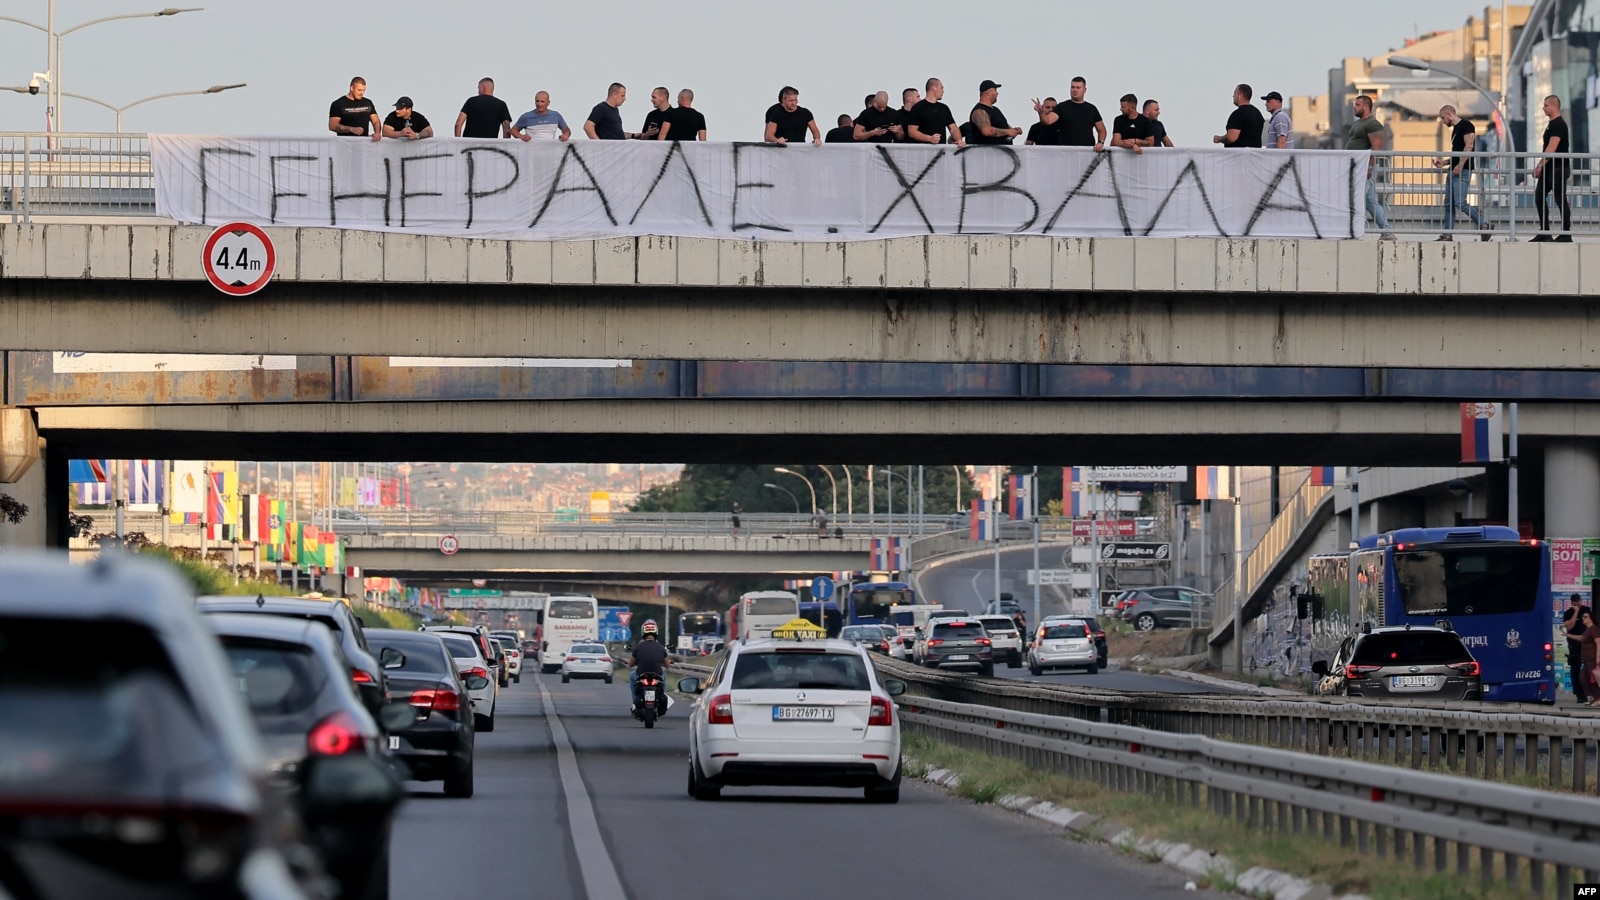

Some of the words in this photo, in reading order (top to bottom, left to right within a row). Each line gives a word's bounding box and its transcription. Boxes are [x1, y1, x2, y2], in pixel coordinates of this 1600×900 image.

[201, 141, 792, 232] ГЕНЕРАЛЕ
[1552, 542, 1580, 550] ПРОТИВ
[797, 630, 817, 639] TAXI
[1461, 635, 1488, 648] оград
[779, 706, 791, 718] BG
